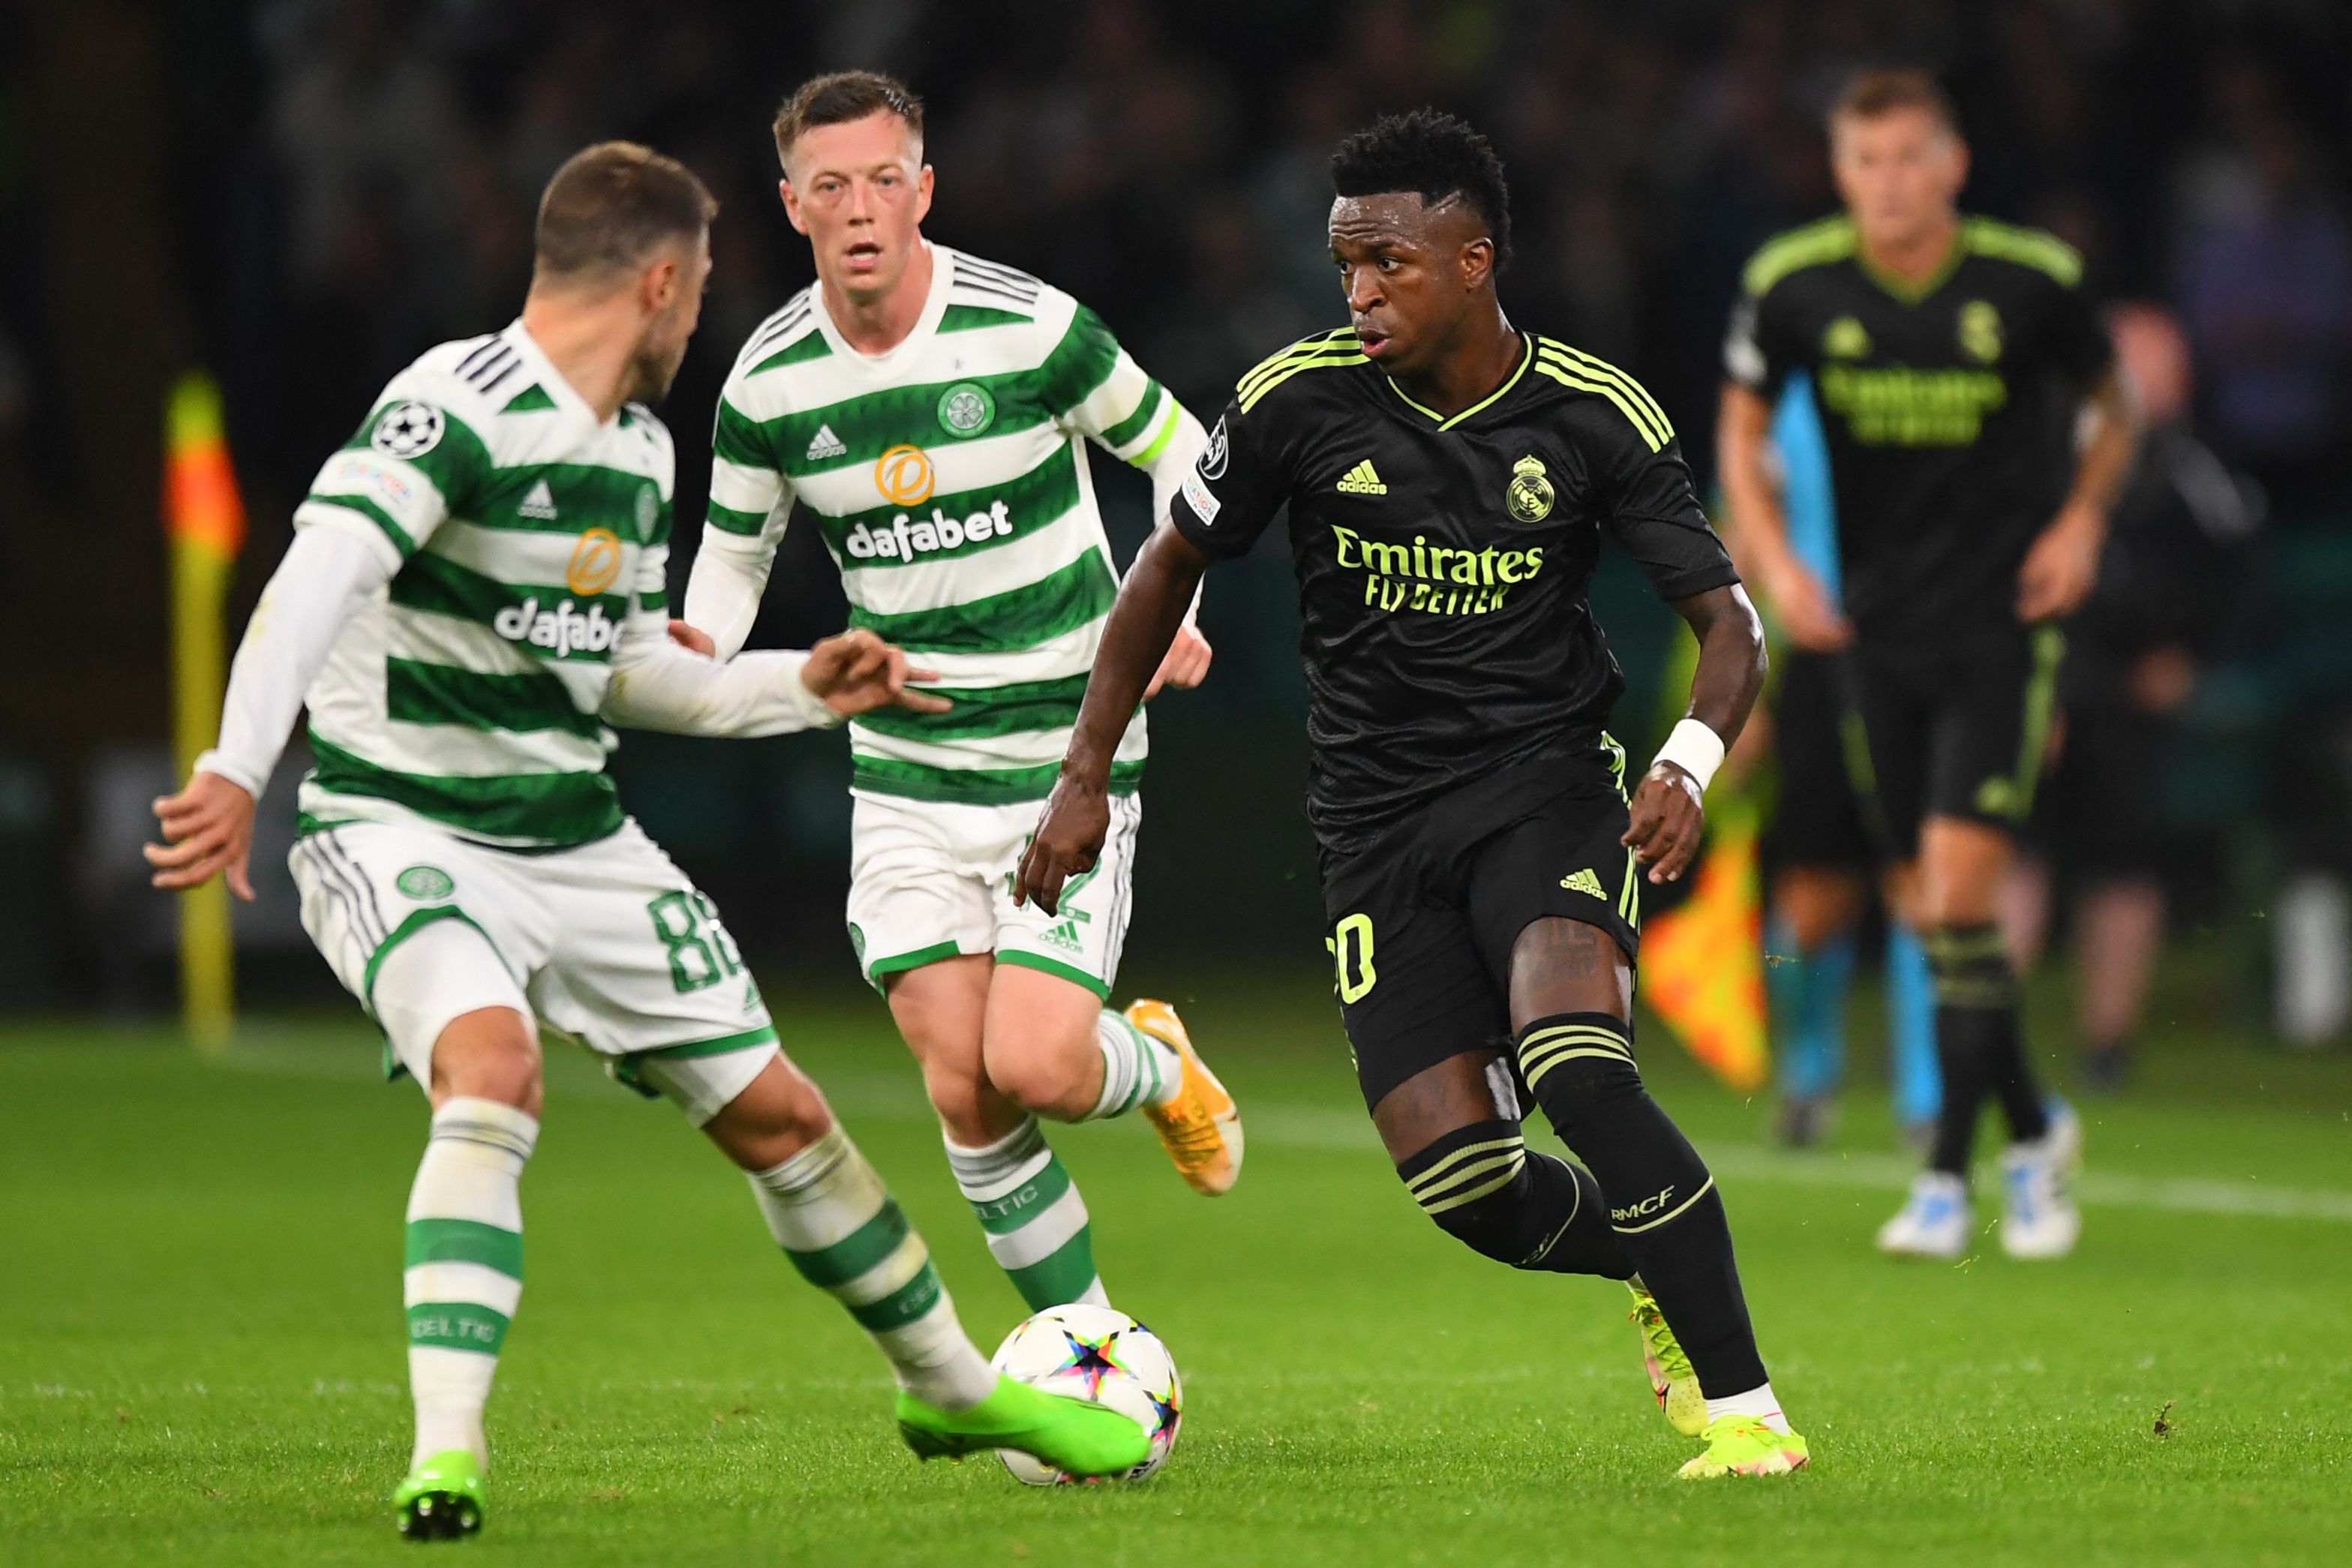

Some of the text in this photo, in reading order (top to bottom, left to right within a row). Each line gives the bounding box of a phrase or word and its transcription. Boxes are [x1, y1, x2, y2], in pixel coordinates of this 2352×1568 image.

[807, 443, 847, 461] adidas
[1336, 480, 1387, 495] adidas
[846, 499, 1014, 563] dafabet
[1330, 524, 1544, 586] Emirates
[1364, 573, 1406, 613] FLY
[1560, 879, 1608, 901] adidas
[1038, 933, 1084, 955] adidas
[1325, 912, 1377, 1005] 0
[1610, 1185, 1675, 1221] RMCF
[410, 1317, 496, 1344] CELTIC
